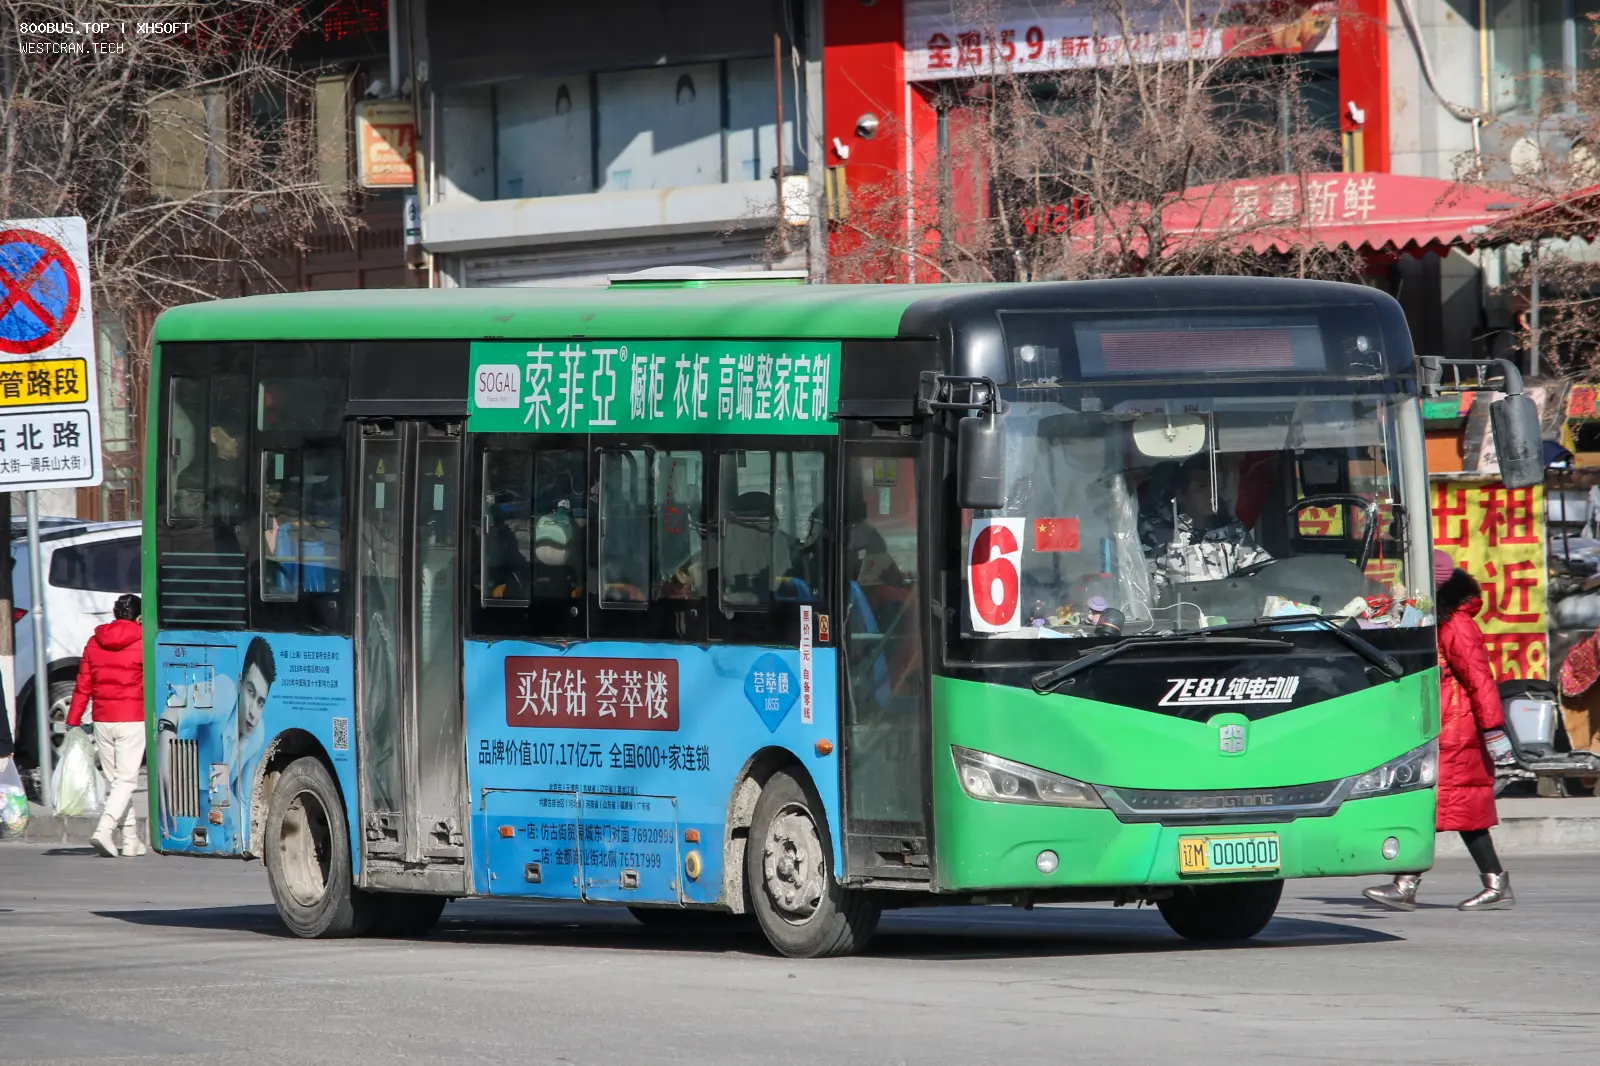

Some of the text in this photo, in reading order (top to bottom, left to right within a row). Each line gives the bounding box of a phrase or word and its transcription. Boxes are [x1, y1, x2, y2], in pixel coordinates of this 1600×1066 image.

[479, 372, 517, 393] SOGAL
[629, 353, 664, 420] 橱柜
[673, 354, 709, 419] 衣柜
[717, 353, 831, 423] 高端整家定制
[1432, 482, 1539, 548] 出租
[970, 524, 1019, 626] 6
[516, 668, 668, 719] 买好钻 荟萃楼
[765, 698, 780, 711] 1855
[478, 739, 710, 771] 品牌价值107.17亿元 全国600+家连锁
[632, 828, 674, 844] 76920999
[619, 852, 662, 869] 76517999
